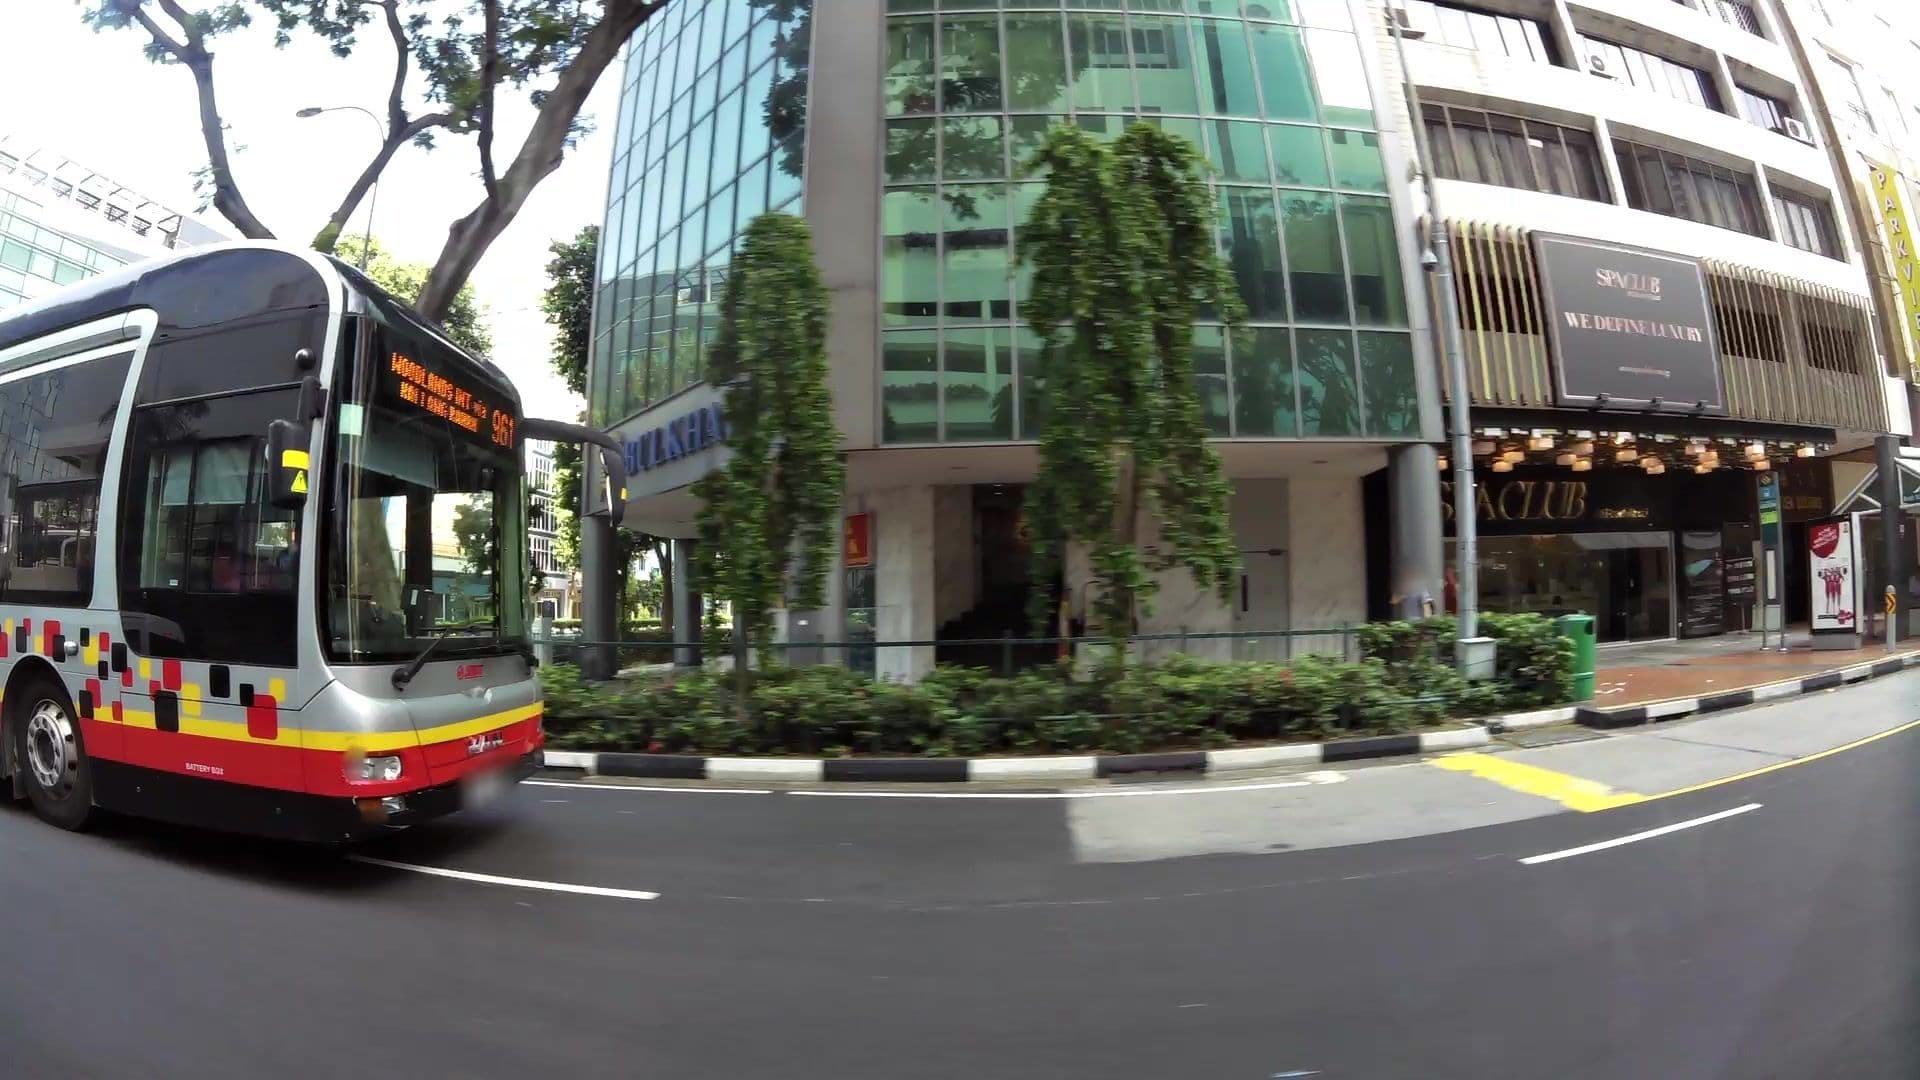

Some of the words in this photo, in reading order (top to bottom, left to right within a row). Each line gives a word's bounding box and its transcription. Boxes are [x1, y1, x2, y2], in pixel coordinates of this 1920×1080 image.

[1564, 311, 1592, 329] WE
[1593, 315, 1649, 336] DEFINE
[1651, 321, 1702, 342] LUXURY
[391, 352, 454, 400] WOODLANDS
[455, 387, 473, 410] INT
[492, 409, 516, 449] 961
[623, 402, 731, 478] BULKHA
[1440, 481, 1587, 520] SACLUB
[185, 762, 210, 773] BATTERY
